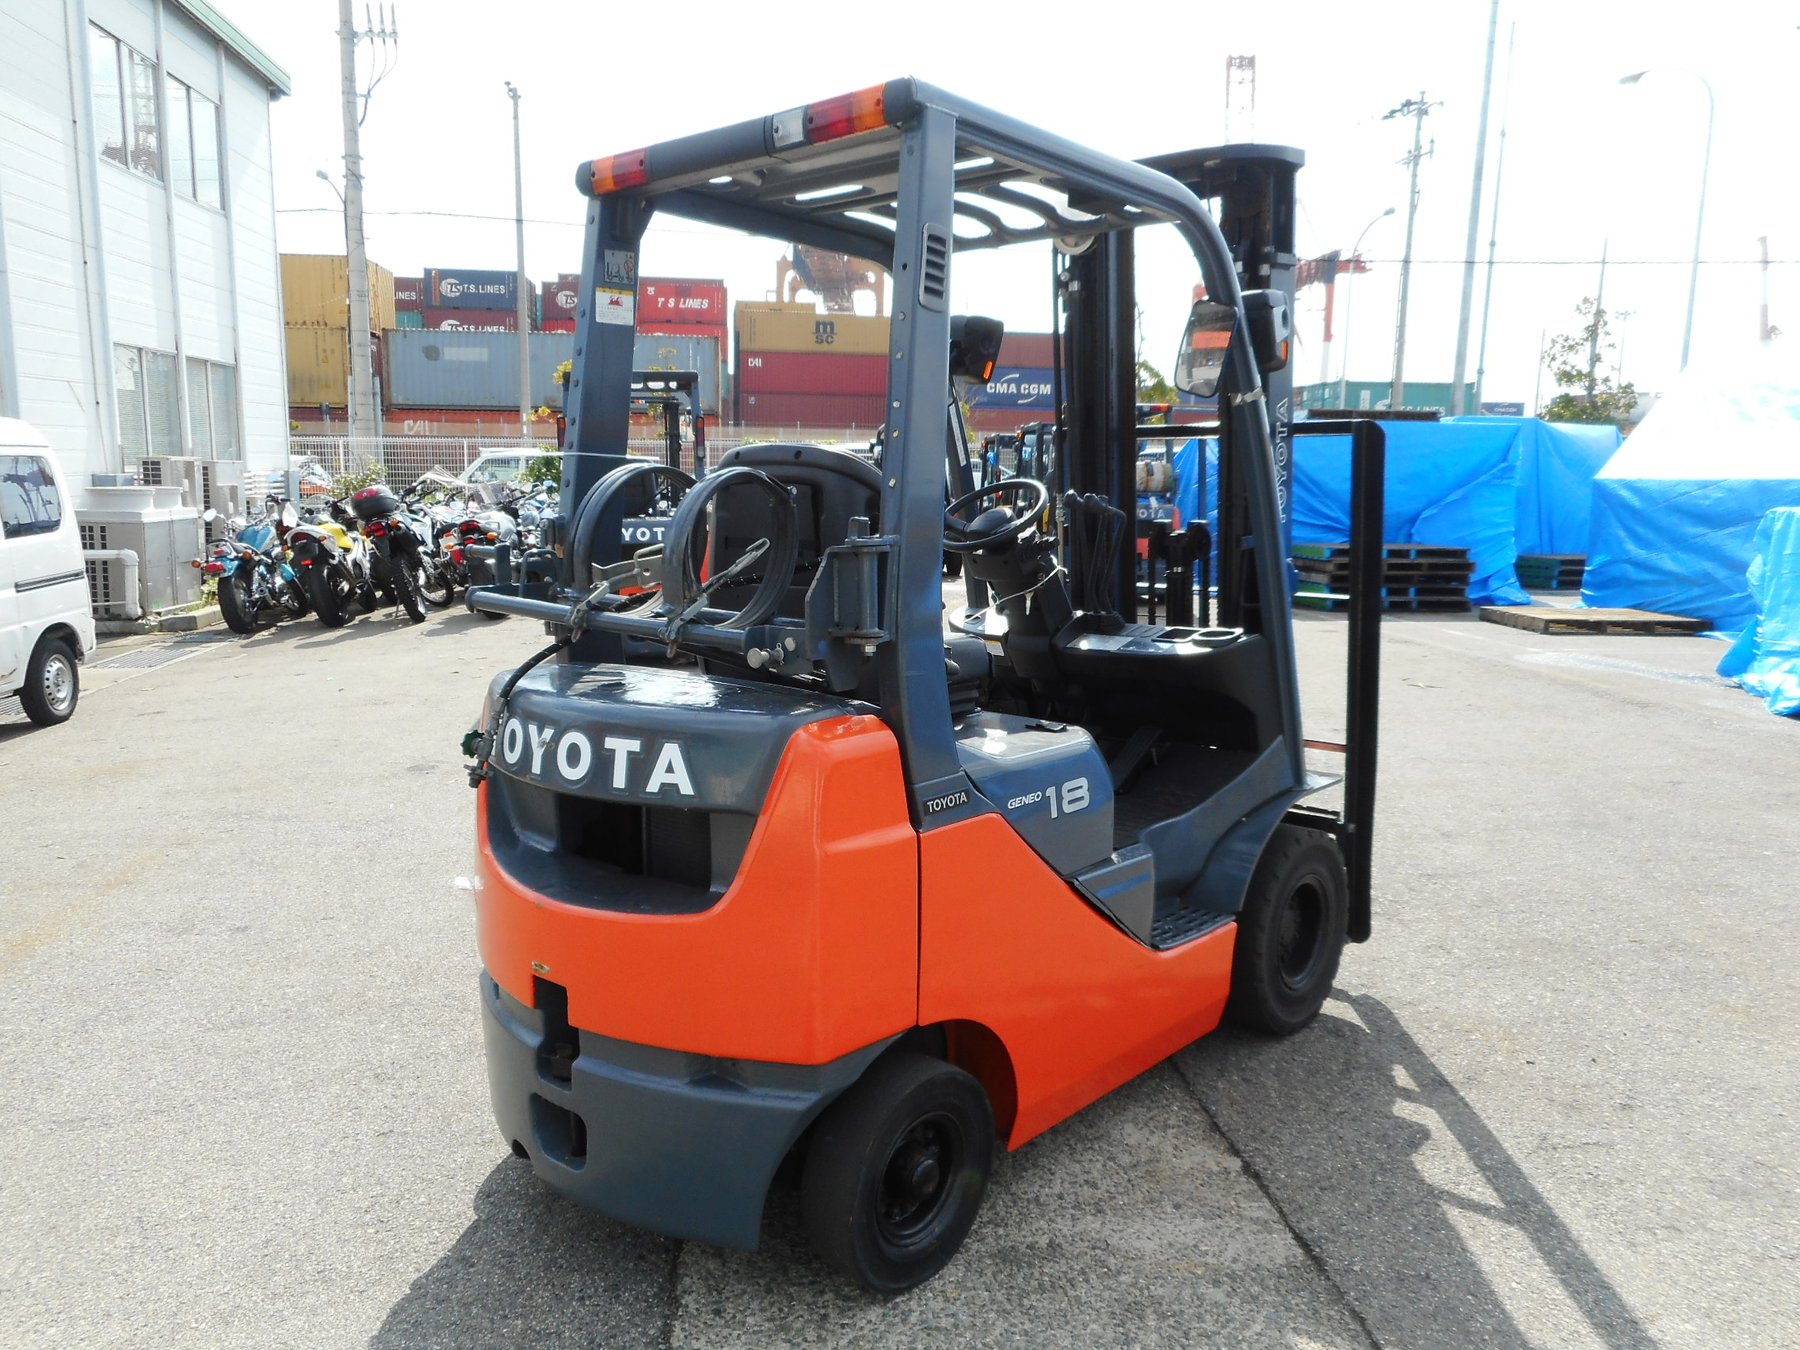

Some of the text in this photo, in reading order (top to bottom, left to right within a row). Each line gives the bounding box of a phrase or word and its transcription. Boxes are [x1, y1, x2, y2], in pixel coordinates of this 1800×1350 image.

[463, 284, 506, 294] T.S. LINES
[563, 294, 576, 304] TS
[658, 298, 709, 309] T S LINES
[986, 382, 1051, 395] CMA CGM
[1275, 397, 1288, 523] OYOTA
[491, 718, 695, 795] OYOTA
[927, 791, 968, 813] TOYOTA
[1007, 776, 1090, 819] GENEO 18
